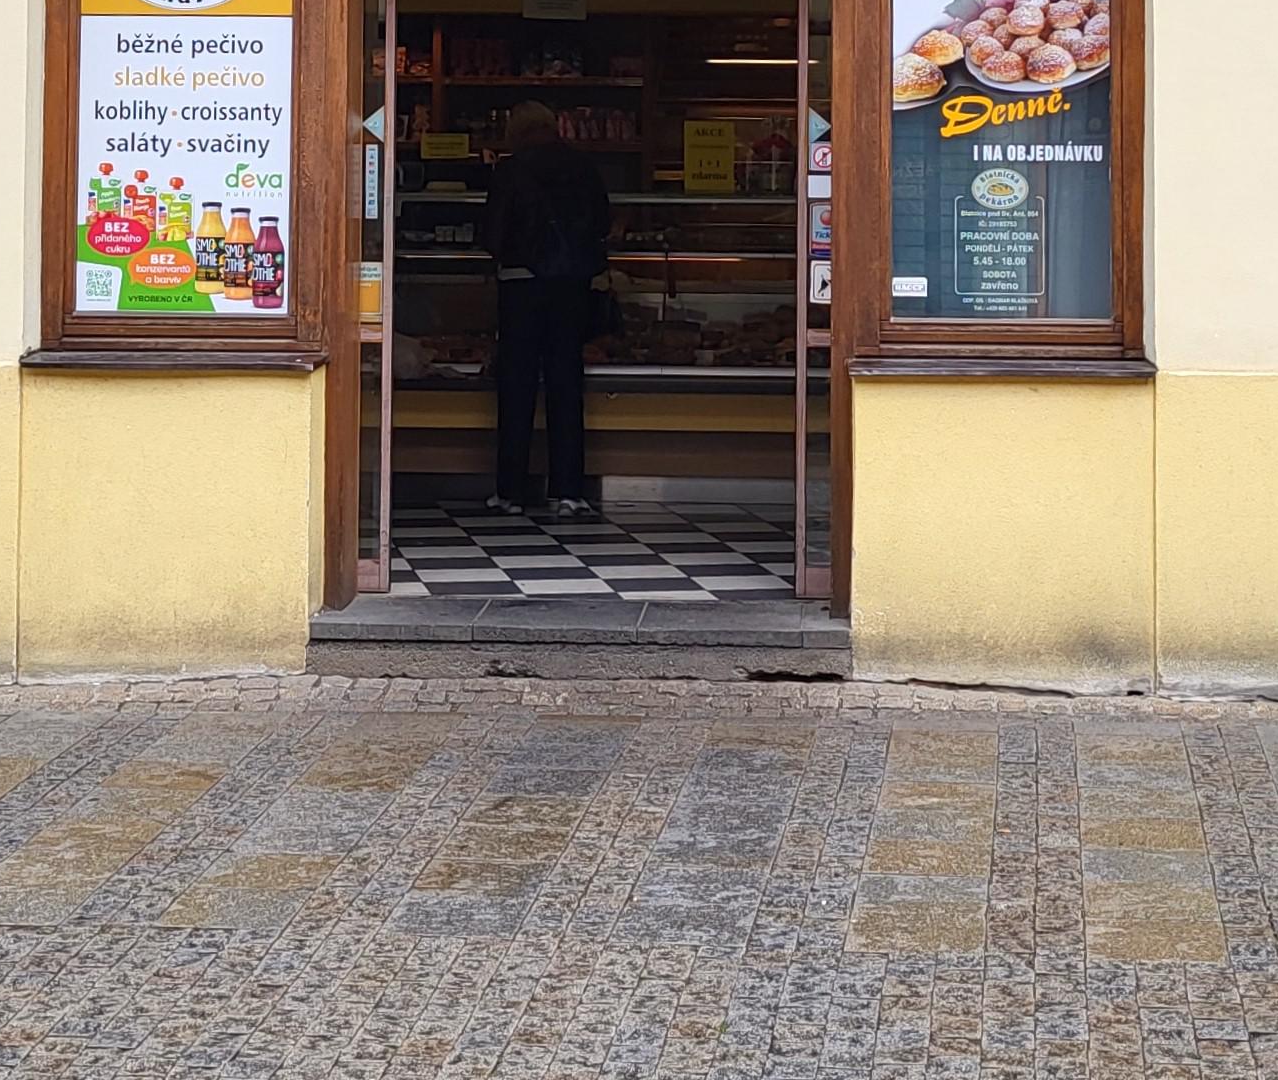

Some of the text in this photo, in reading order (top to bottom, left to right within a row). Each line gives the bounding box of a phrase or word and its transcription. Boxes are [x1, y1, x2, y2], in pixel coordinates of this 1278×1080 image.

[116, 33, 264, 59] běžné pečivo
[114, 66, 265, 91] sladké pečivo
[94, 99, 283, 126] koblihy croissanty
[106, 131, 270, 158] saláty svačiny
[983, 144, 1003, 161] NA
[1007, 141, 1103, 162] OBJEDNÁVKU
[225, 163, 283, 188] deva
[104, 222, 130, 232] BEZ
[94, 233, 141, 244] přidaného
[960, 231, 1039, 240] PRACOVNÍ DOBA
[1007, 243, 1034, 252] PÁTEK
[150, 254, 175, 264] BEZ
[973, 256, 993, 265] 5.45
[1002, 256, 1026, 265] 18.00
[982, 270, 1017, 278] SOBOTA
[981, 281, 1019, 290] zavřeno
